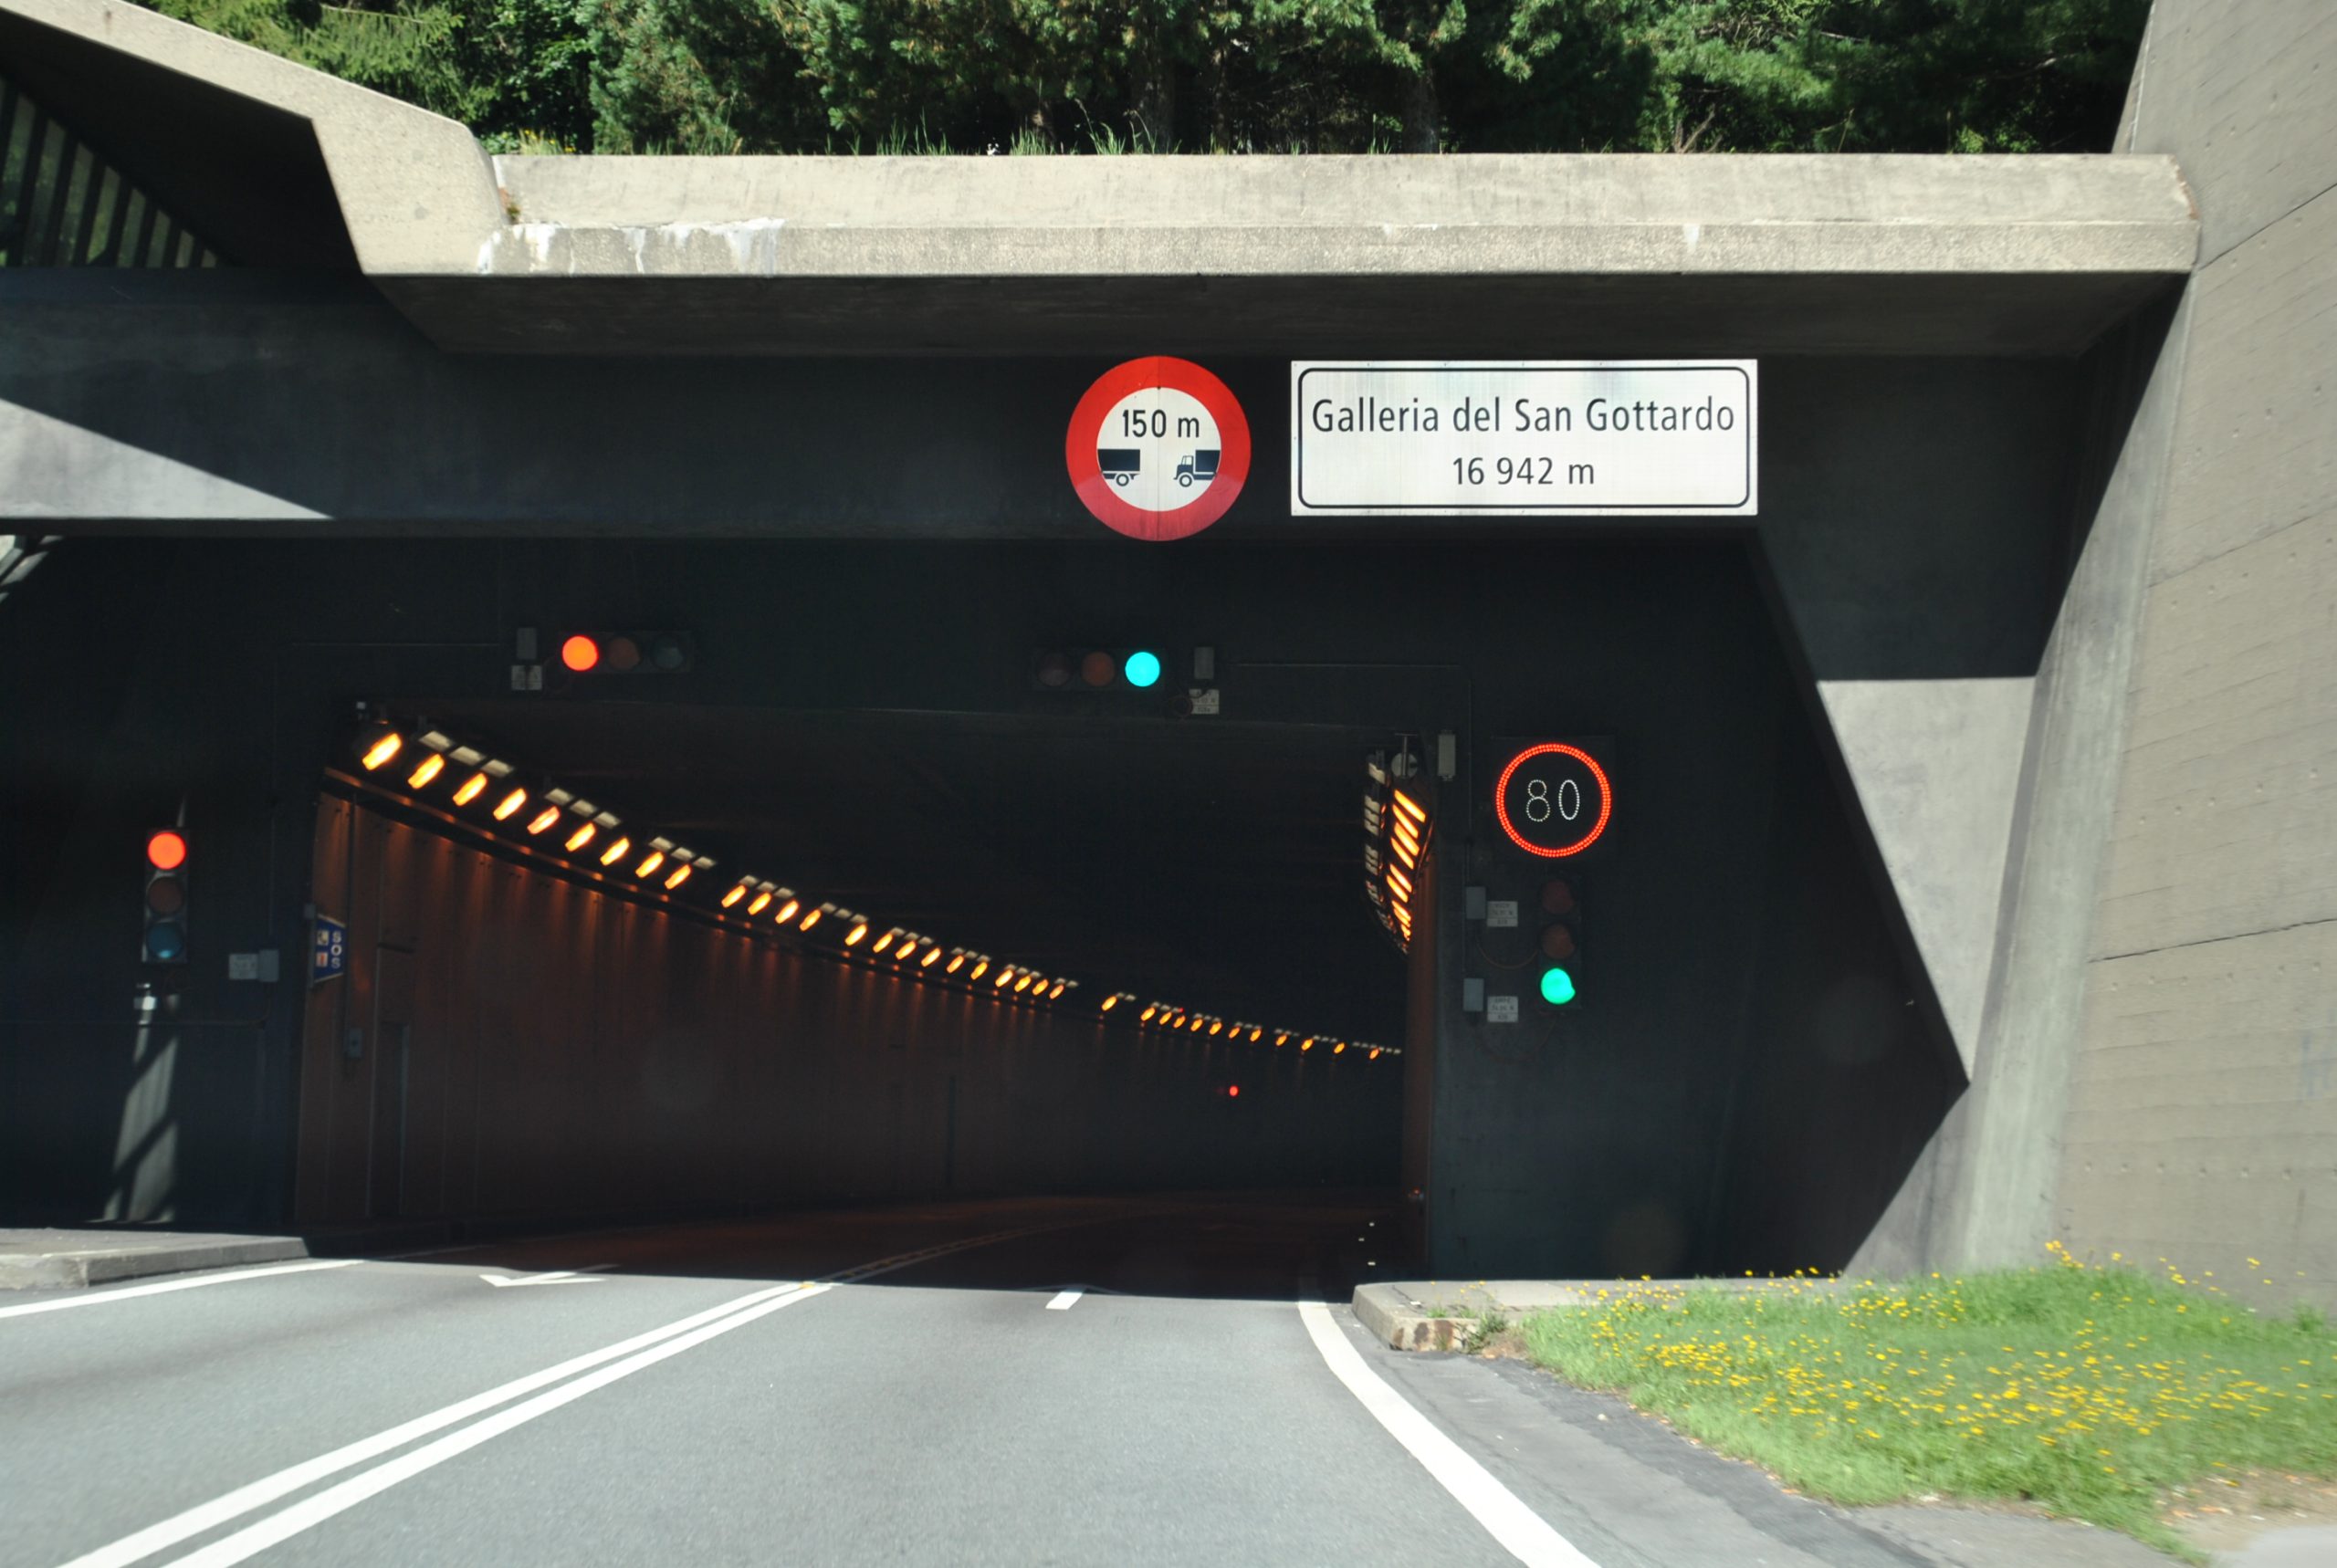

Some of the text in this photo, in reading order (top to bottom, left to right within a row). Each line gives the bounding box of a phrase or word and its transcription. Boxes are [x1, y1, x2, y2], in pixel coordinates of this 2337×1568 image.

[1122, 409, 1200, 438] 150 m
[1312, 395, 1734, 433] Galleria del San Gottardo
[1453, 457, 1595, 486] 16 942 m
[1526, 779, 1580, 822] 80
[331, 931, 342, 969] SOS
